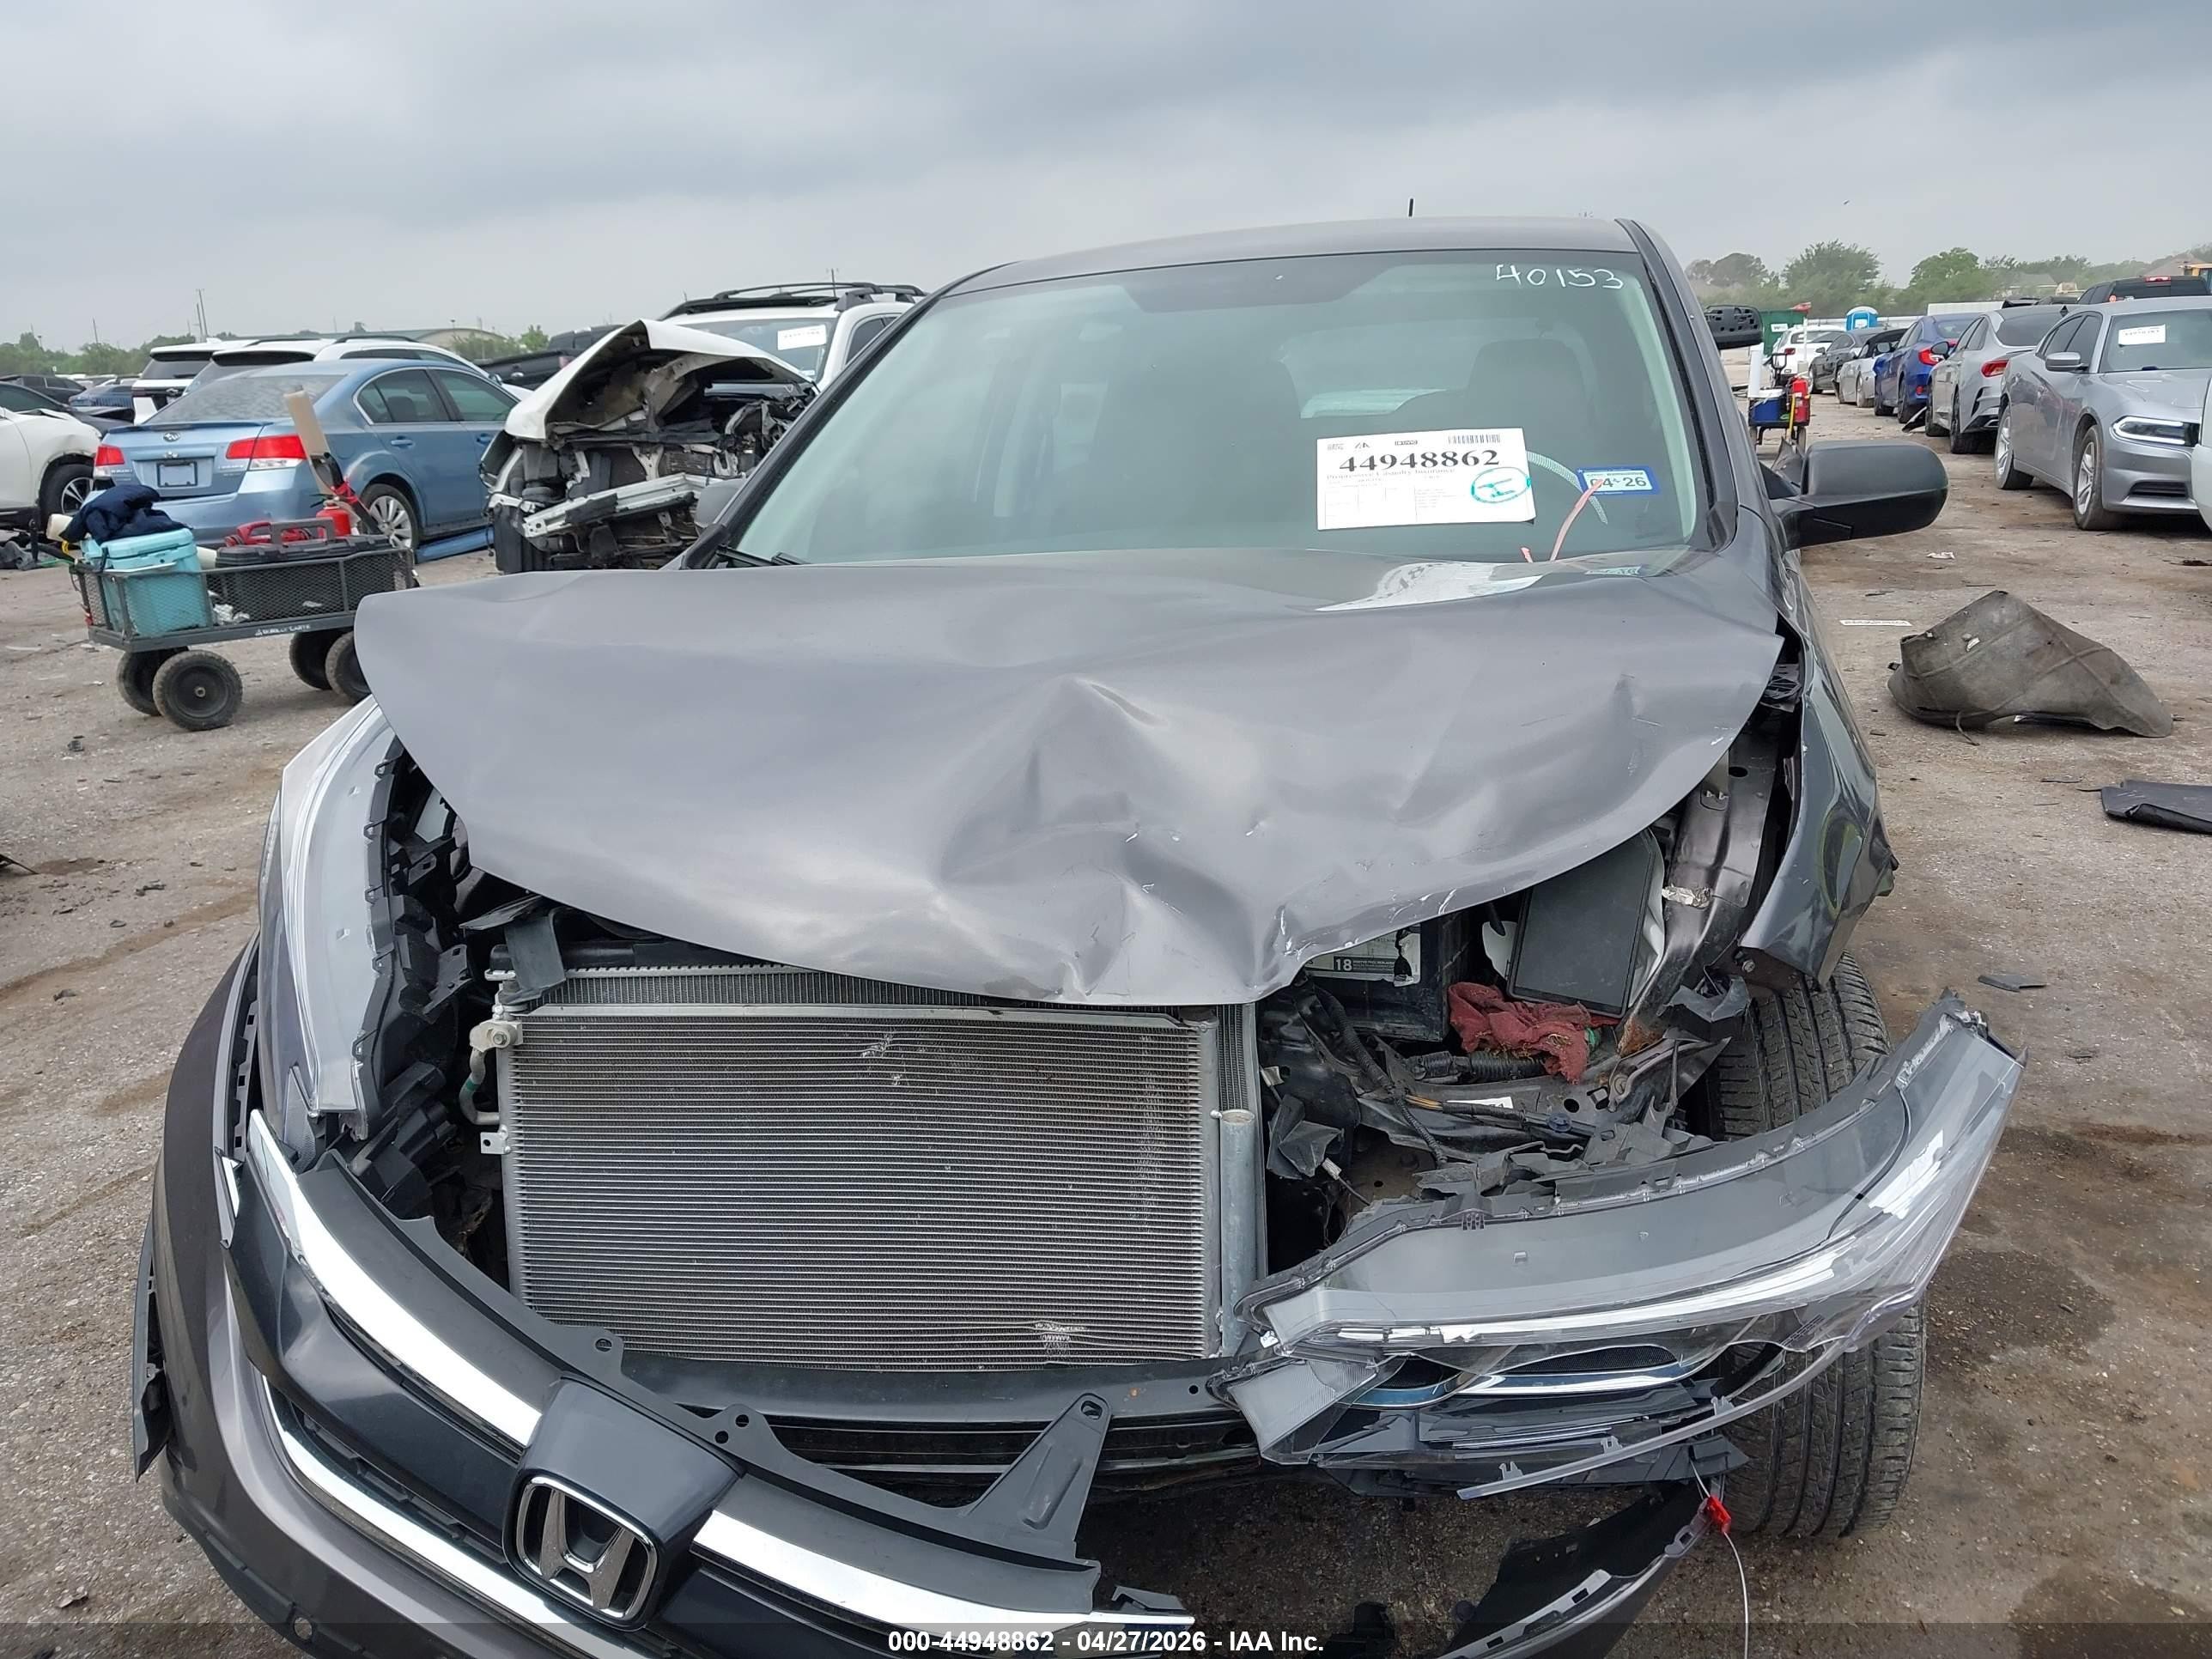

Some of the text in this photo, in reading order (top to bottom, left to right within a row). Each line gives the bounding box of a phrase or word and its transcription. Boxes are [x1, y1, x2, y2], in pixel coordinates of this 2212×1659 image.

[1496, 264, 1624, 289] 40153
[1339, 448, 1500, 472] 44948862
[1335, 957, 1352, 972] 18
